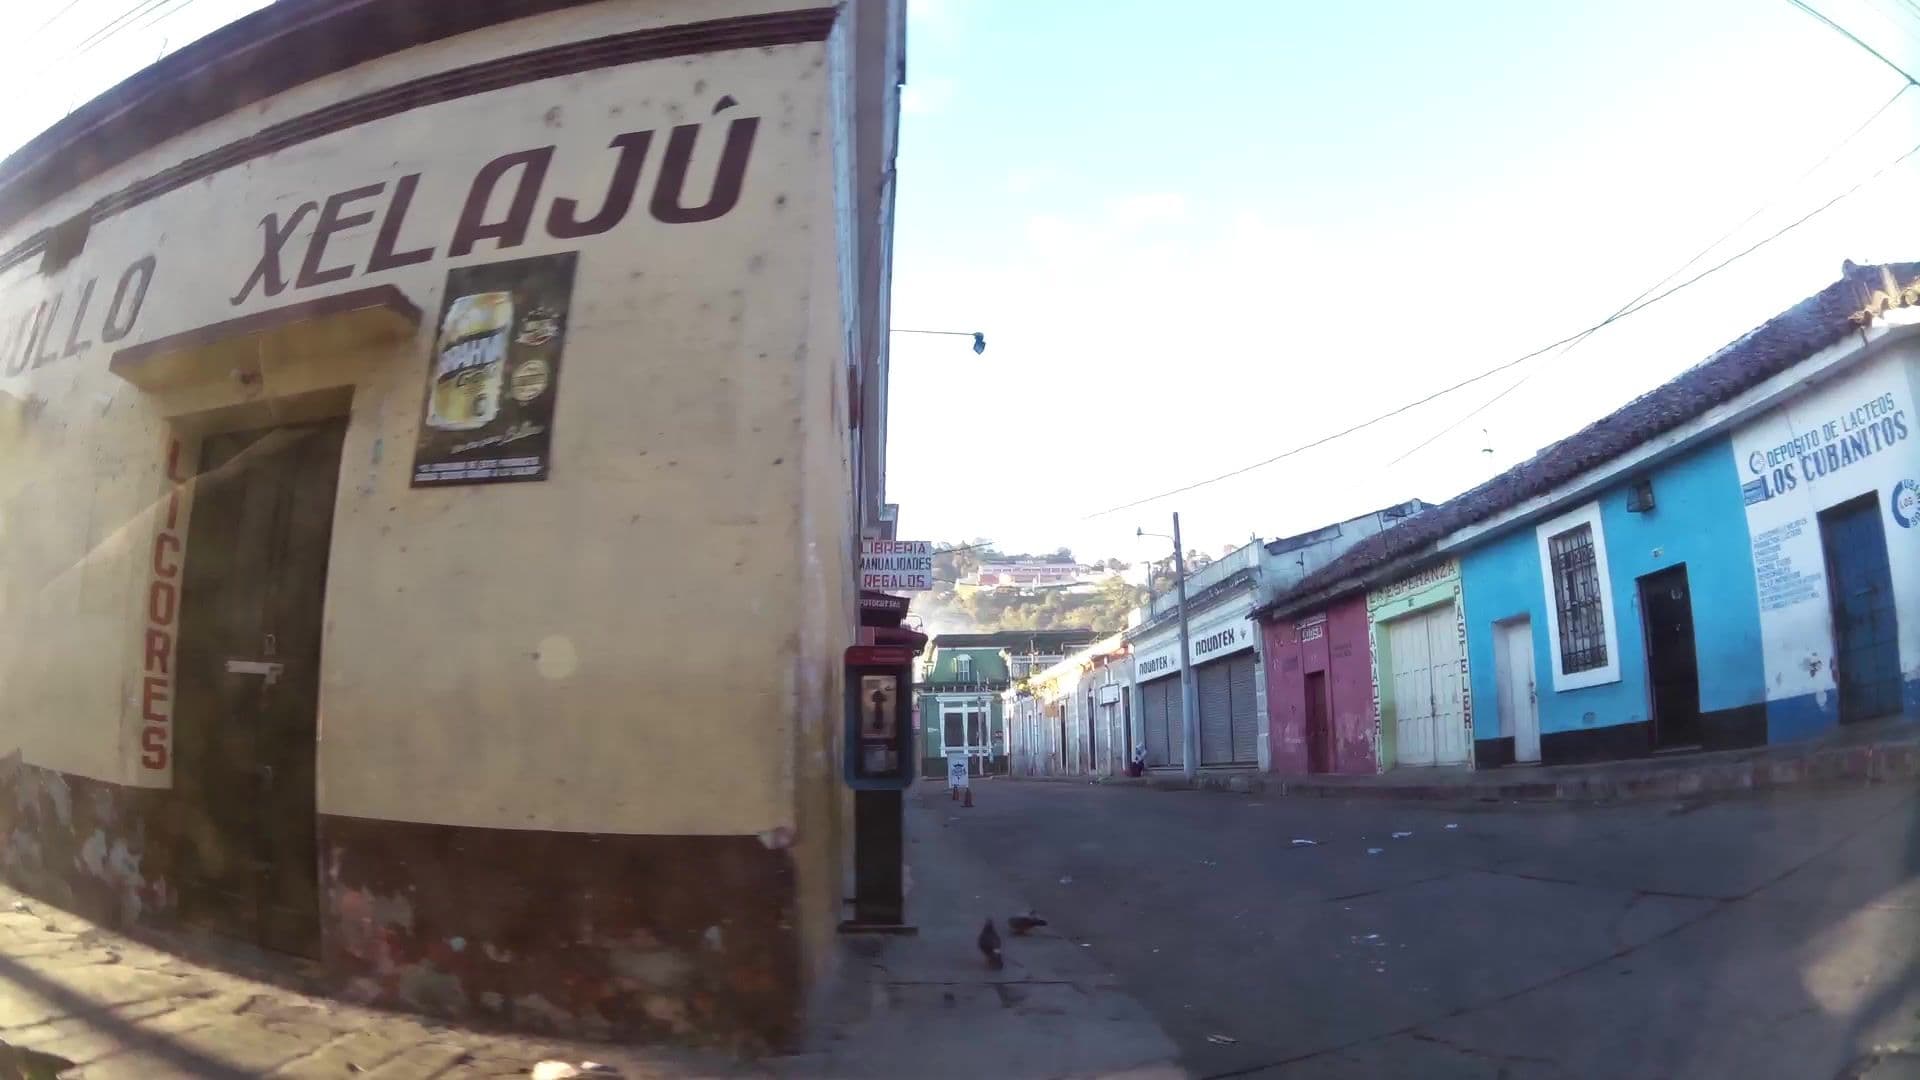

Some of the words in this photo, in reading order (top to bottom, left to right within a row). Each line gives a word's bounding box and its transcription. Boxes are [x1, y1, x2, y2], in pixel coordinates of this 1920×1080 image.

[231, 96, 760, 306] XELAJÚ
[1760, 463, 1797, 500] LOS
[1801, 409, 1908, 482] CUBANITOS
[1766, 428, 1820, 468] DEPOSITO
[1822, 420, 1839, 442] DE
[1841, 392, 1895, 432] LACTEOS
[860, 542, 926, 554] LIBRERIA
[860, 557, 931, 570] MANUALIDADES
[864, 574, 924, 588] REGALOS
[142, 439, 184, 770] LICORES
[1453, 583, 1474, 769] PASTELERIA
